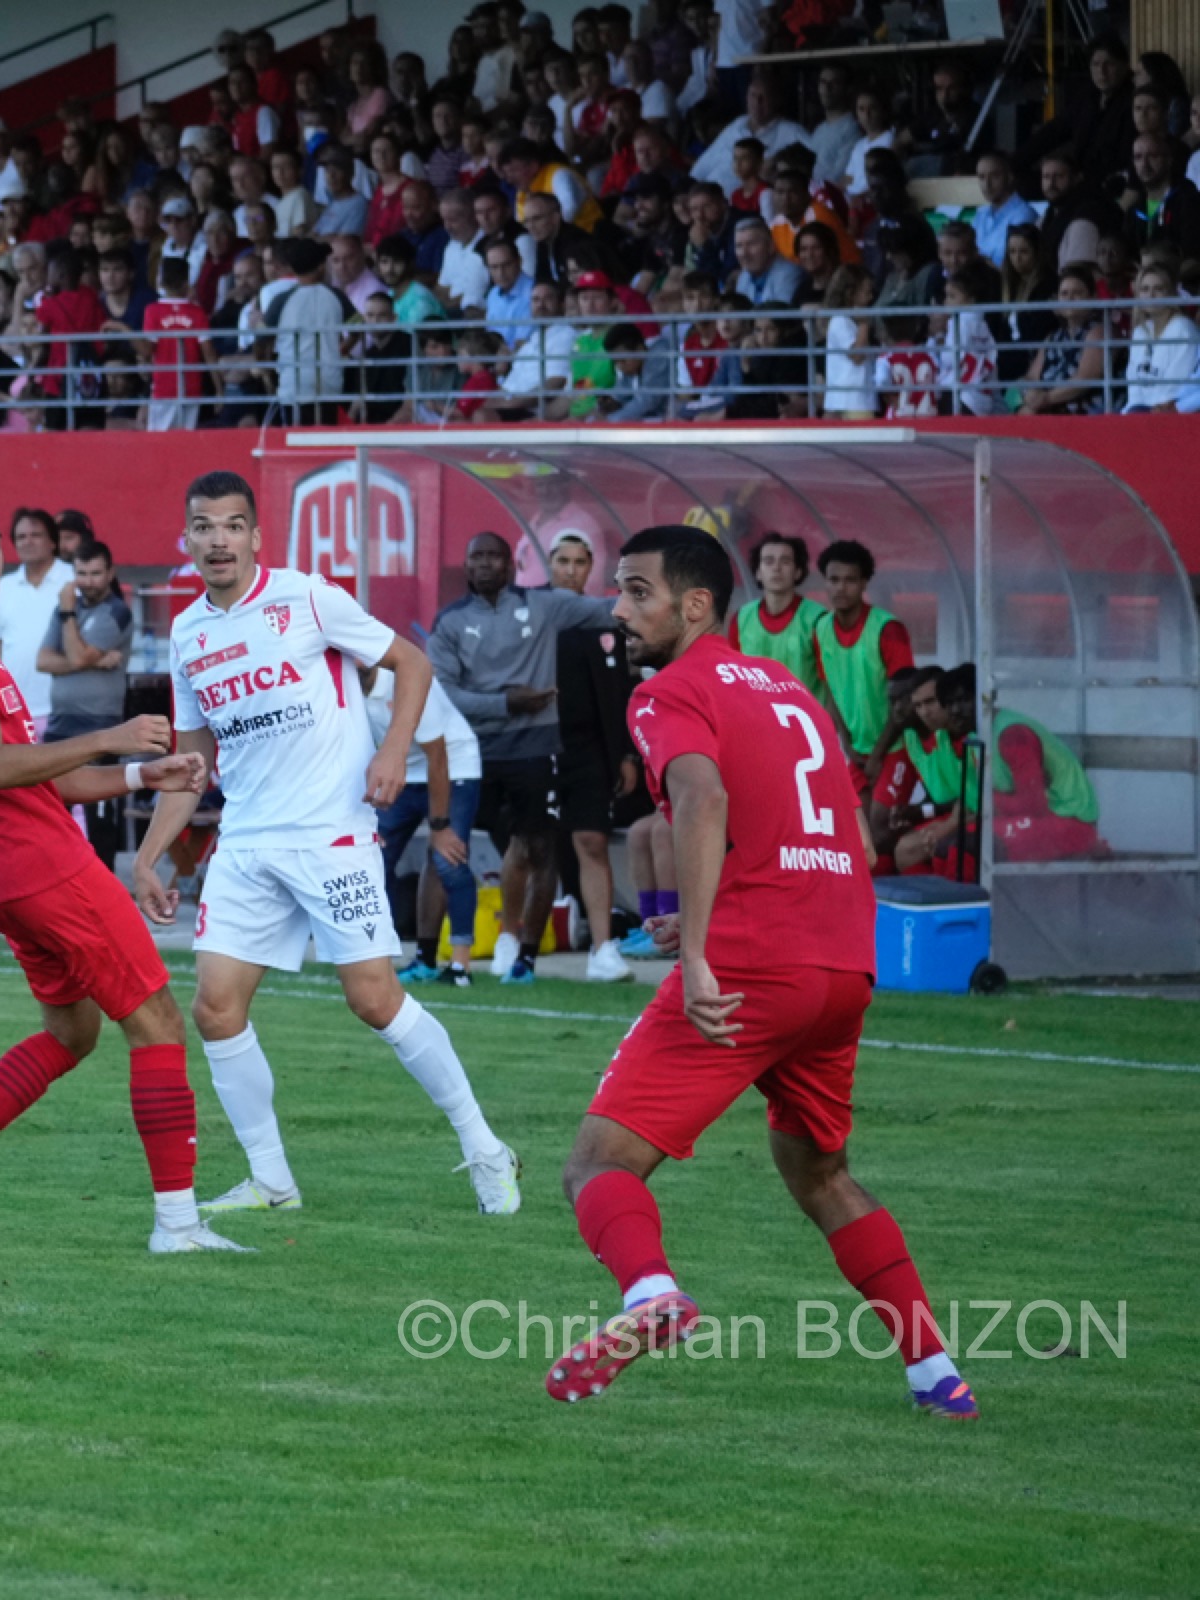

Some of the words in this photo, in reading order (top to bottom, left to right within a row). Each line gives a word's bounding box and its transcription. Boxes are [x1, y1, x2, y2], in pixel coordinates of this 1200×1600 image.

[715, 662, 772, 685] STAR
[770, 701, 835, 836] 2
[323, 870, 369, 895] SWISS
[327, 885, 379, 909] GRAPE
[333, 901, 383, 924] FORCE
